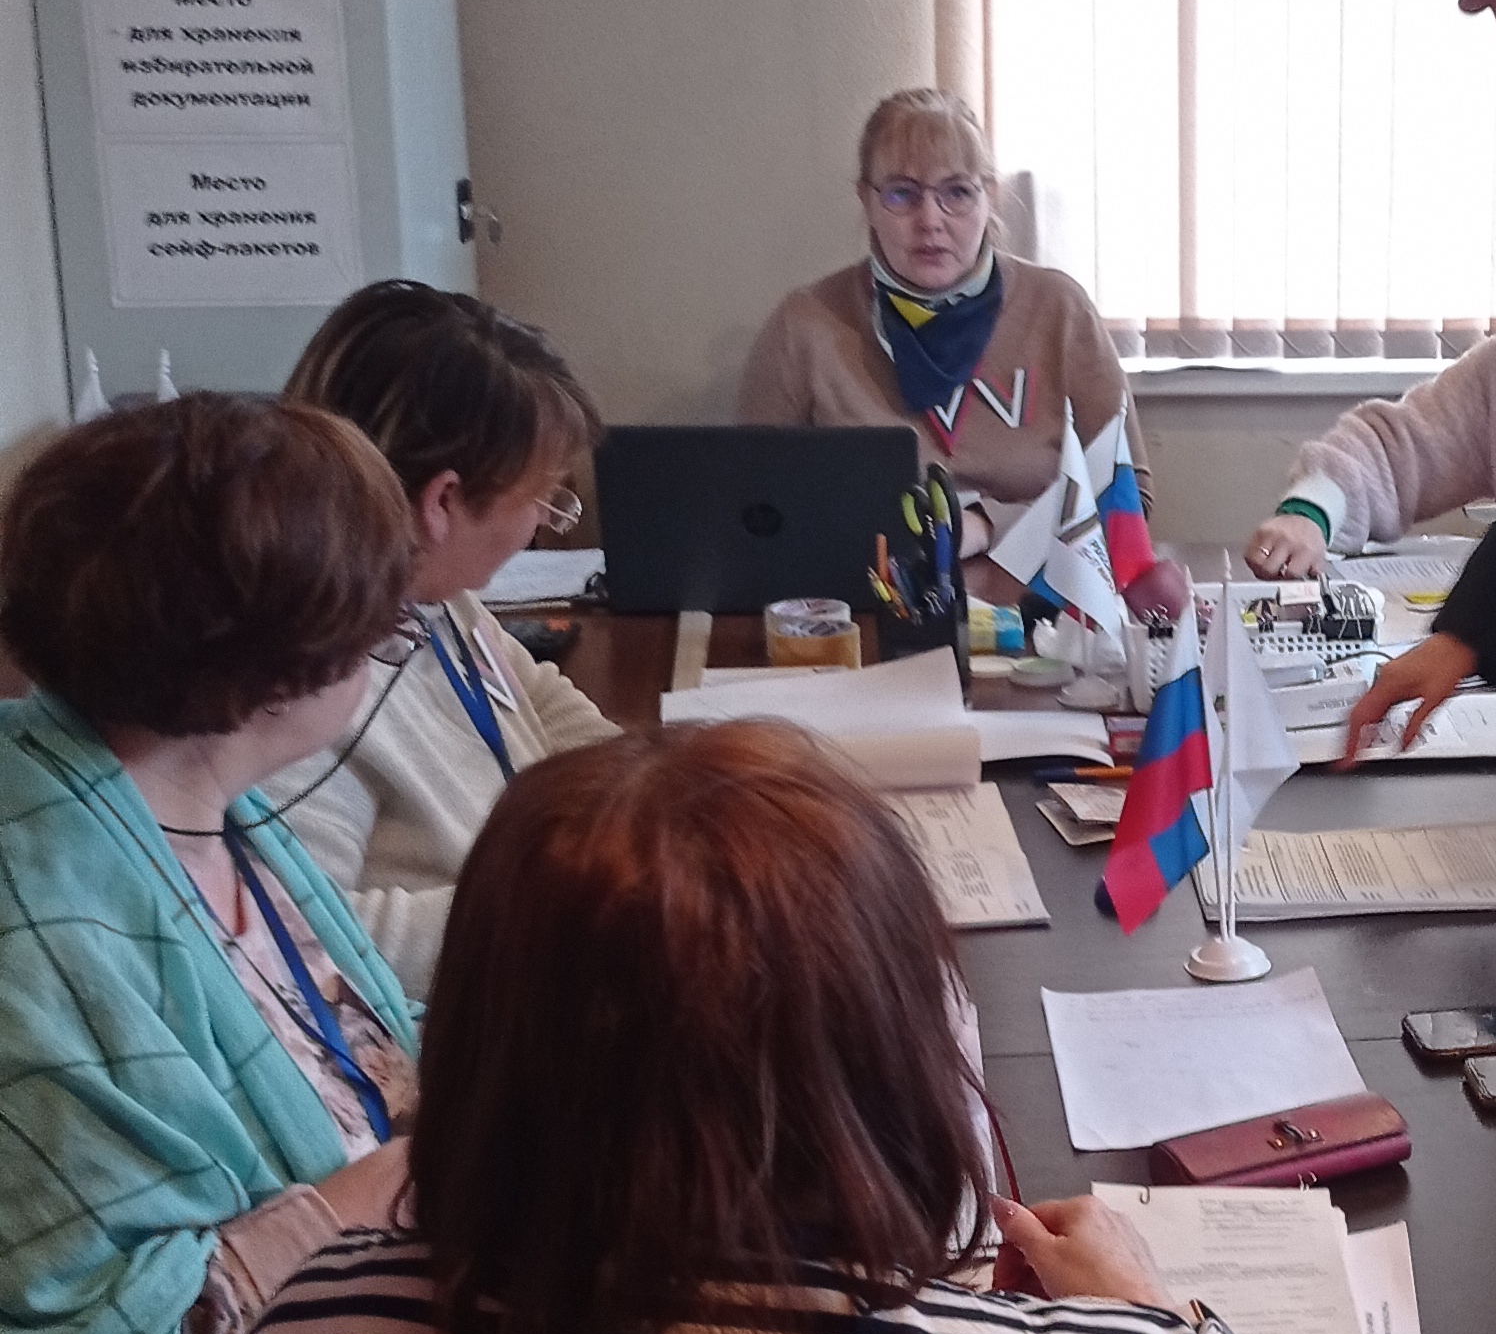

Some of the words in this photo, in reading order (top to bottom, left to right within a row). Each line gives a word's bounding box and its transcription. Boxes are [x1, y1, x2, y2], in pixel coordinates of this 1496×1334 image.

[129, 26, 173, 43] для
[179, 26, 302, 45] хранения
[190, 173, 267, 191] Место
[148, 211, 190, 226] для
[196, 211, 316, 228] хранения
